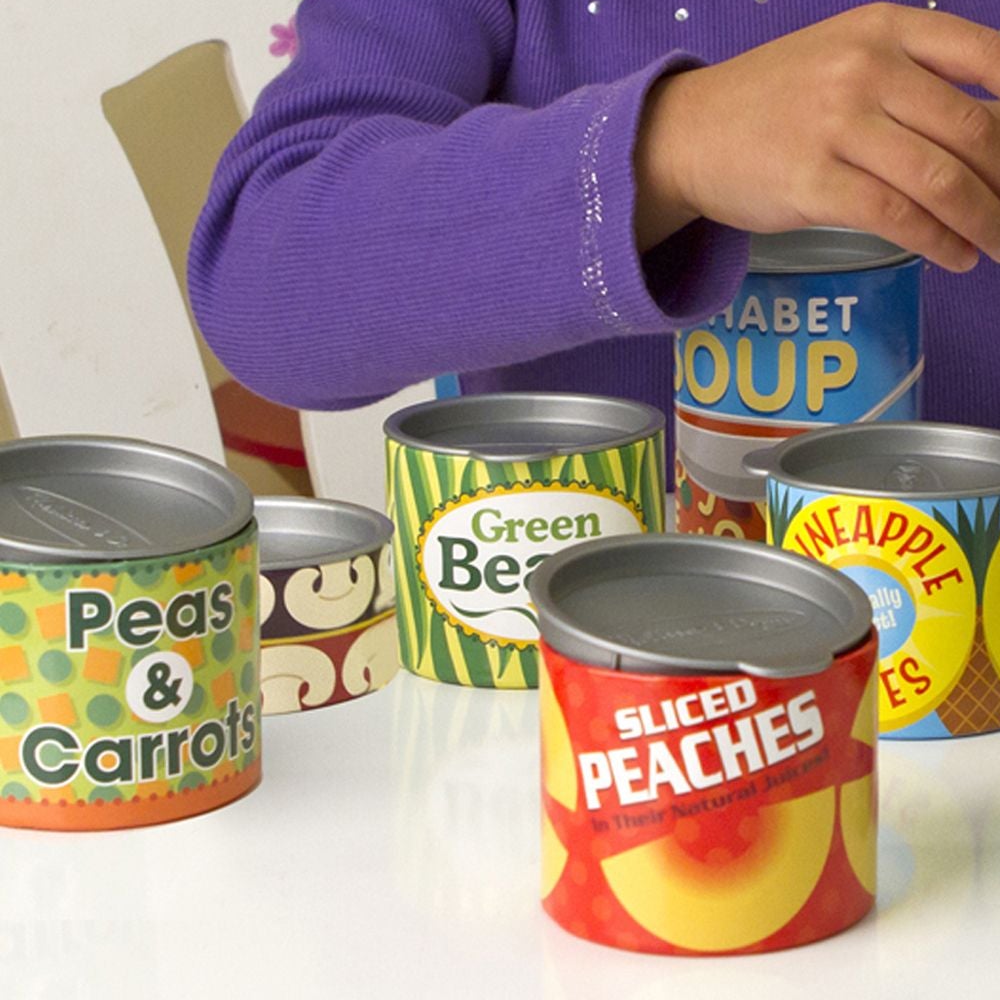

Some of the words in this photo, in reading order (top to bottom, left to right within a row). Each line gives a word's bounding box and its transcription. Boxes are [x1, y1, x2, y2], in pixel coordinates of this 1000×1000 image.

[675, 329, 858, 412] OUP
[471, 508, 602, 543] Green
[793, 504, 964, 596] INEAPPLE
[66, 581, 234, 652] Peas
[142, 661, 183, 711] &
[614, 677, 758, 741] SLICED
[19, 697, 257, 789] Carrots
[578, 689, 825, 811] PEACHES
[612, 810, 665, 831] Their
[670, 782, 758, 819] Natural
